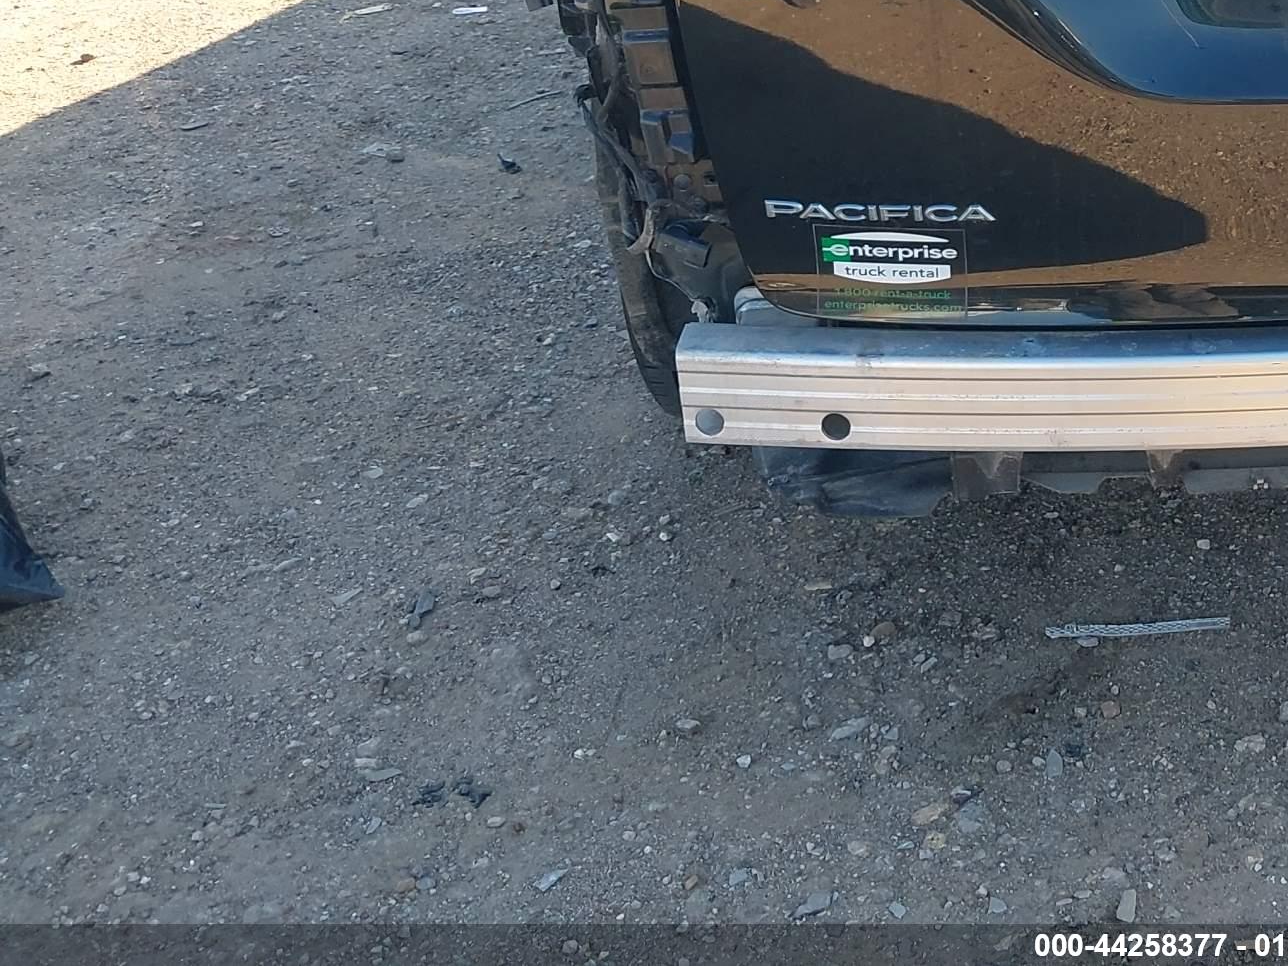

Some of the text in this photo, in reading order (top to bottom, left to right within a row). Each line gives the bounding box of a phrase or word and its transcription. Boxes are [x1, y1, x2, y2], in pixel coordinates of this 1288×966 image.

[764, 199, 995, 222] PACIFICA
[823, 242, 958, 261] enterprise
[845, 265, 939, 279] truck rental
